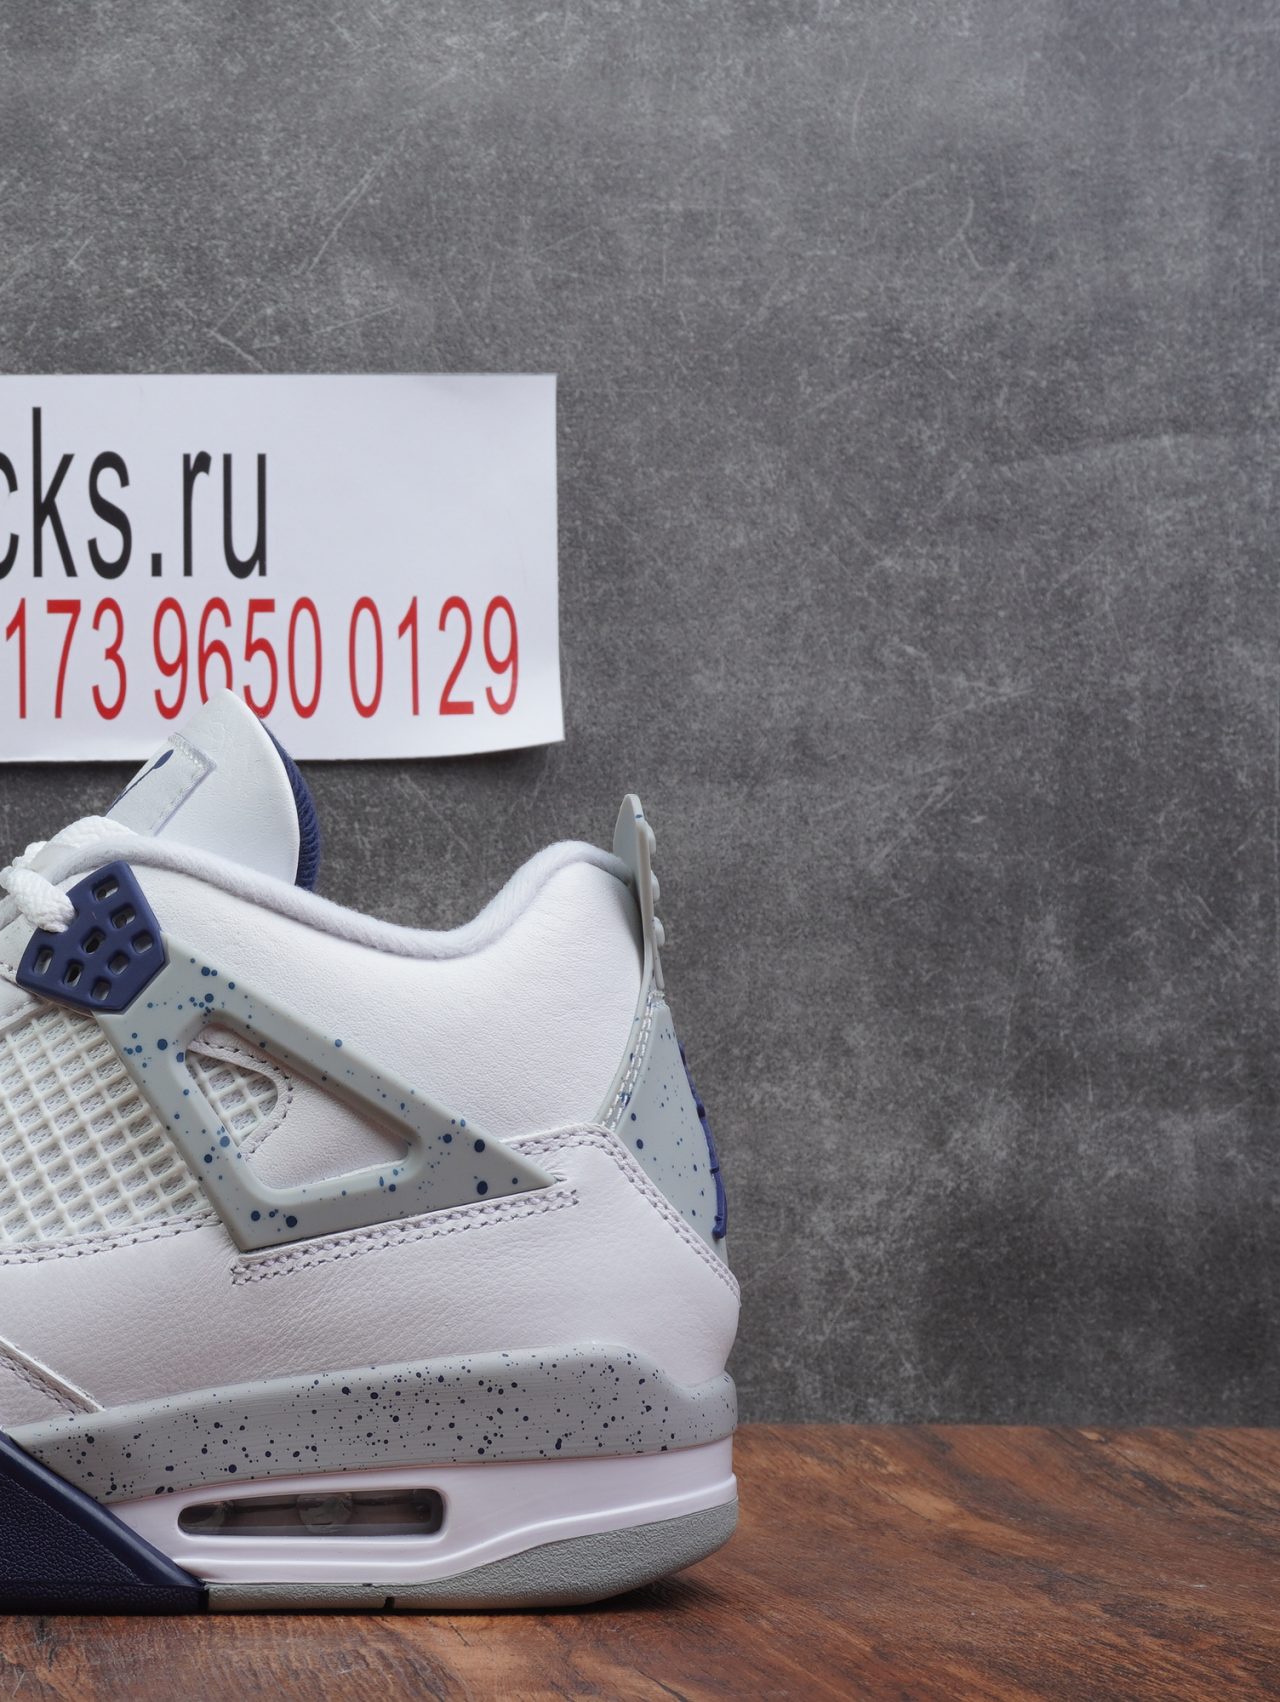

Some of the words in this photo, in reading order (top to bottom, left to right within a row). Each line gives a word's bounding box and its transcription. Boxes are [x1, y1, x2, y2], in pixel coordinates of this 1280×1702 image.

[6, 598, 126, 720] 173
[153, 598, 322, 719] 9650
[349, 596, 518, 718] 0129
